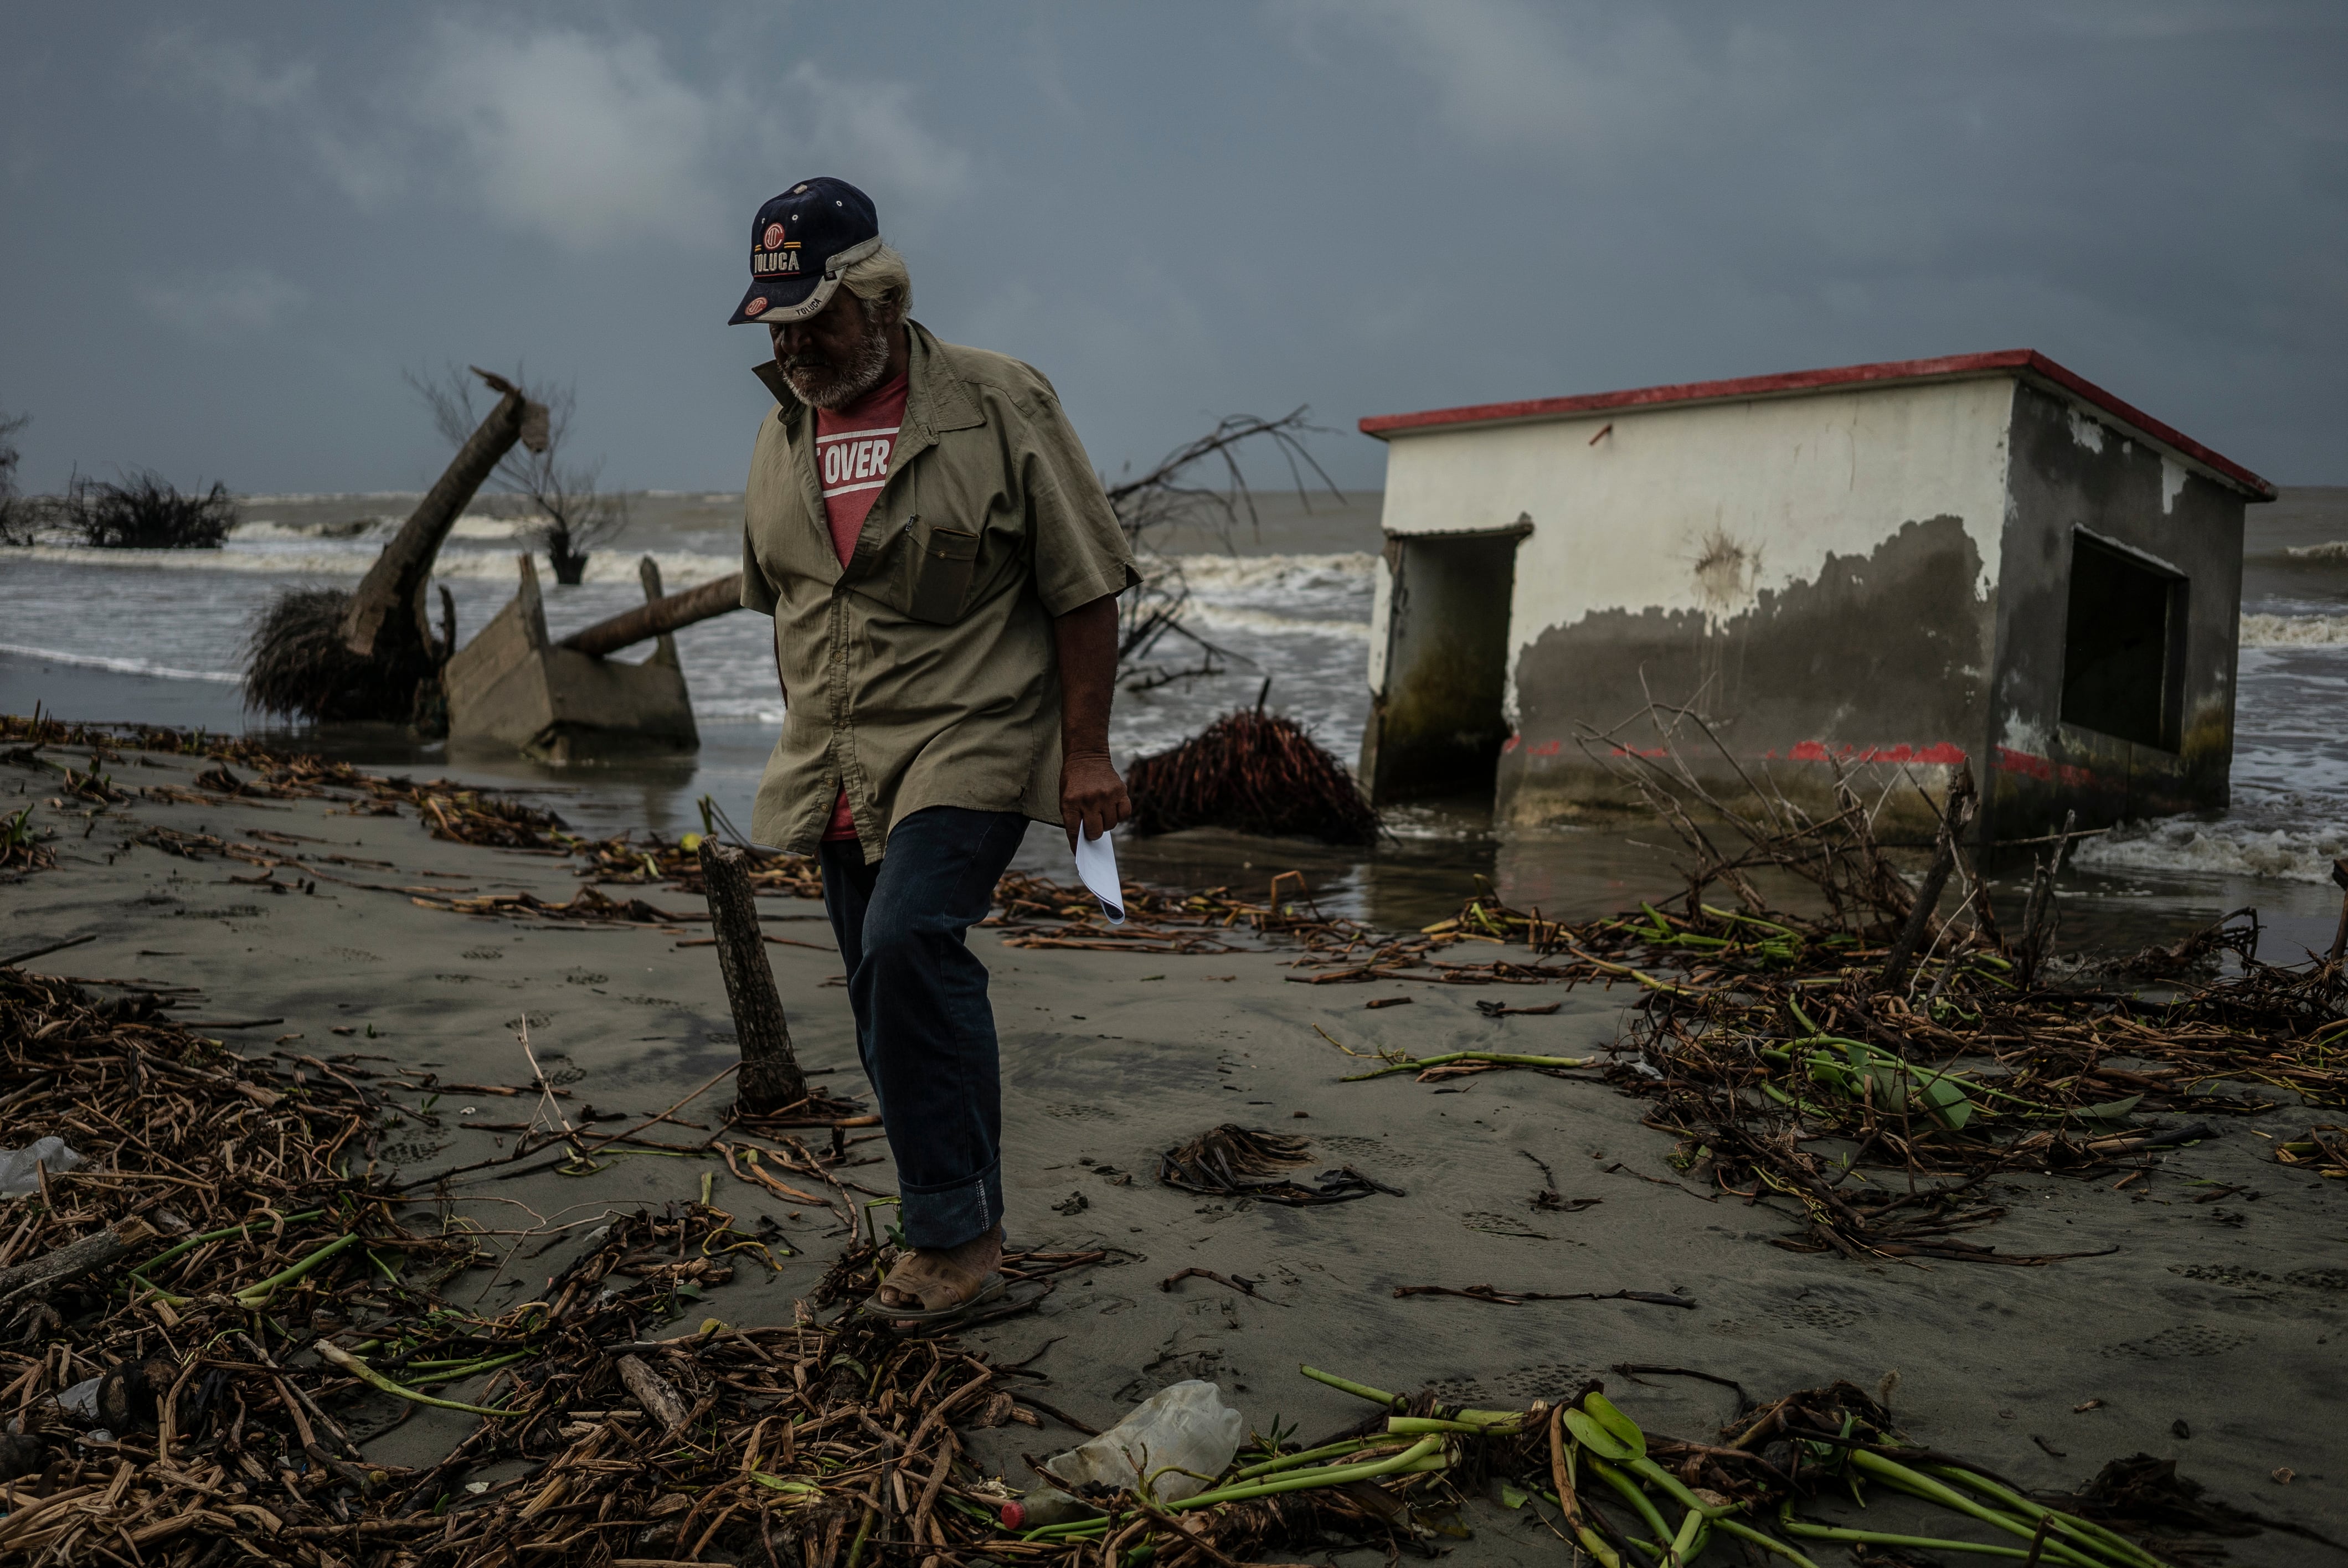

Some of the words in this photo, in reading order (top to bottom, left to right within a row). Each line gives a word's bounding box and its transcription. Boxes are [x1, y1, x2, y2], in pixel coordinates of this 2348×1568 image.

[754, 251, 800, 273] TOLUCA
[795, 298, 822, 316] TOLUCA
[825, 440, 890, 484] OVER
